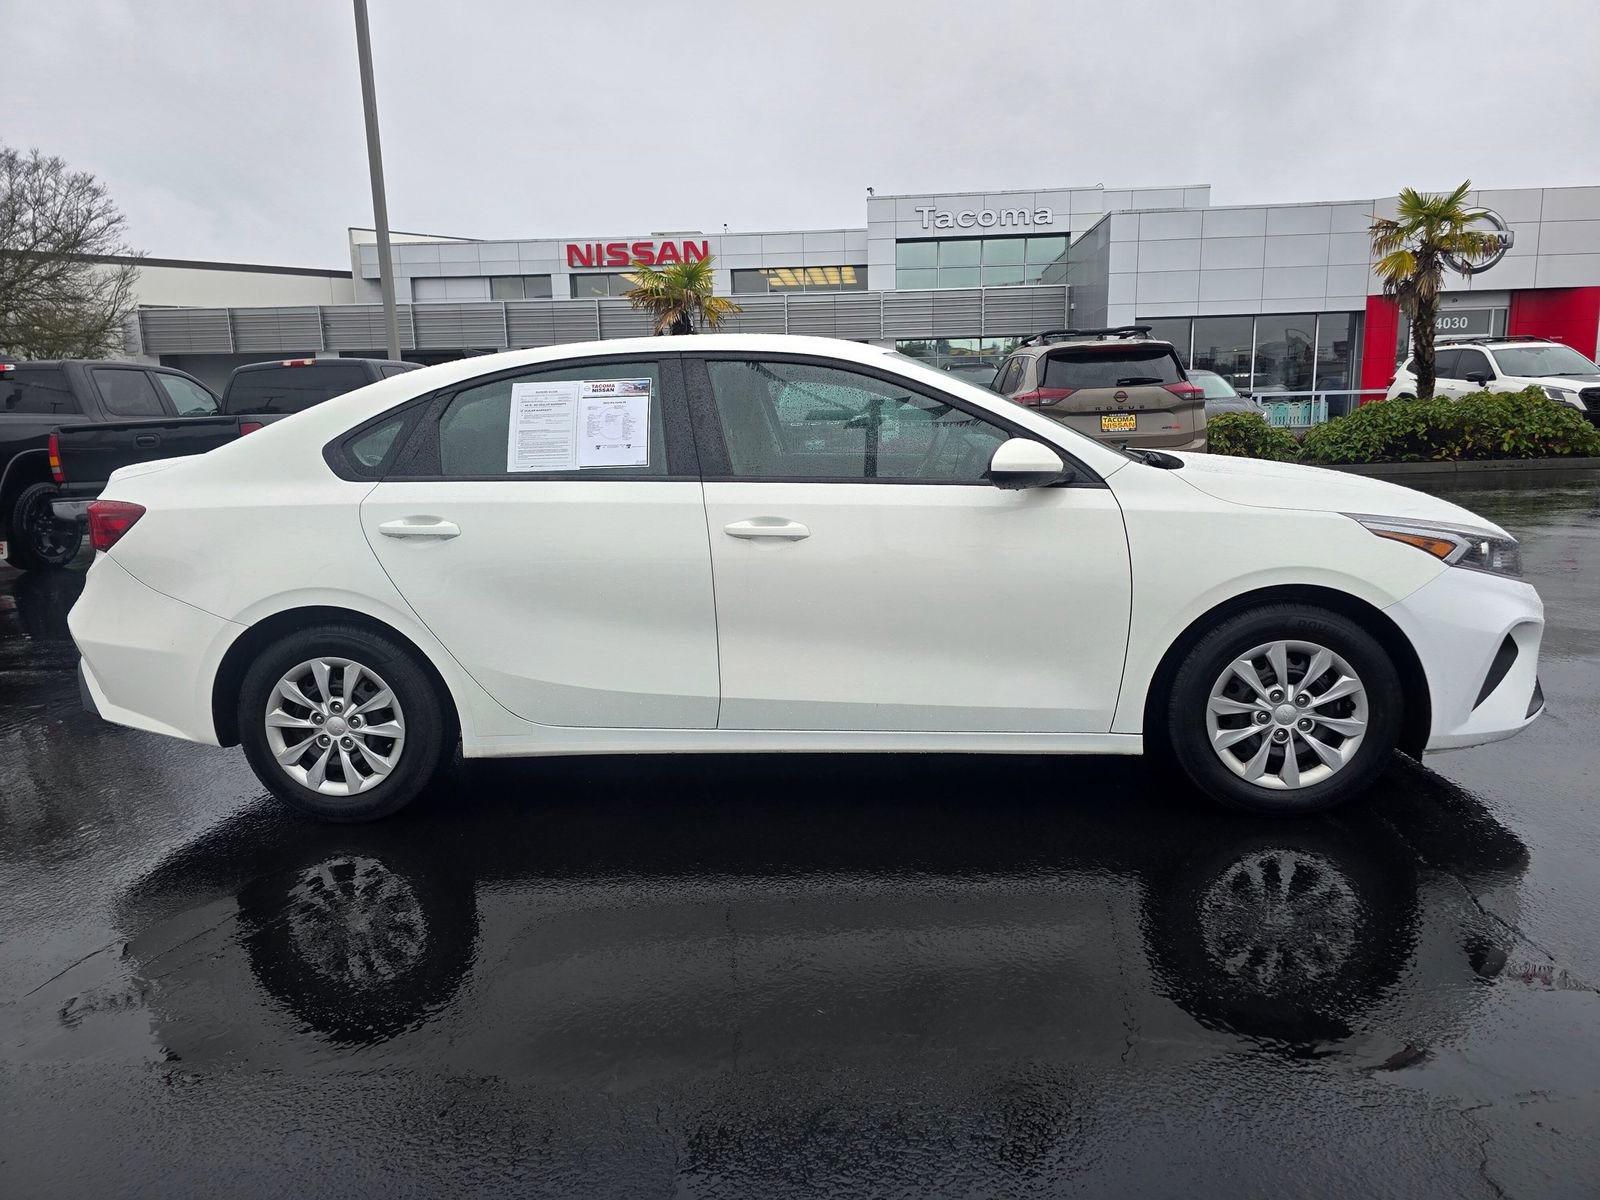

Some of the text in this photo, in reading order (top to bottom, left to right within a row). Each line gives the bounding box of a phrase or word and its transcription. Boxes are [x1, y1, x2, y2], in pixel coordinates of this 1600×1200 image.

[915, 206, 1053, 229] Tacoma
[566, 240, 709, 267] NISSAN
[1435, 317, 1468, 329] 4030
